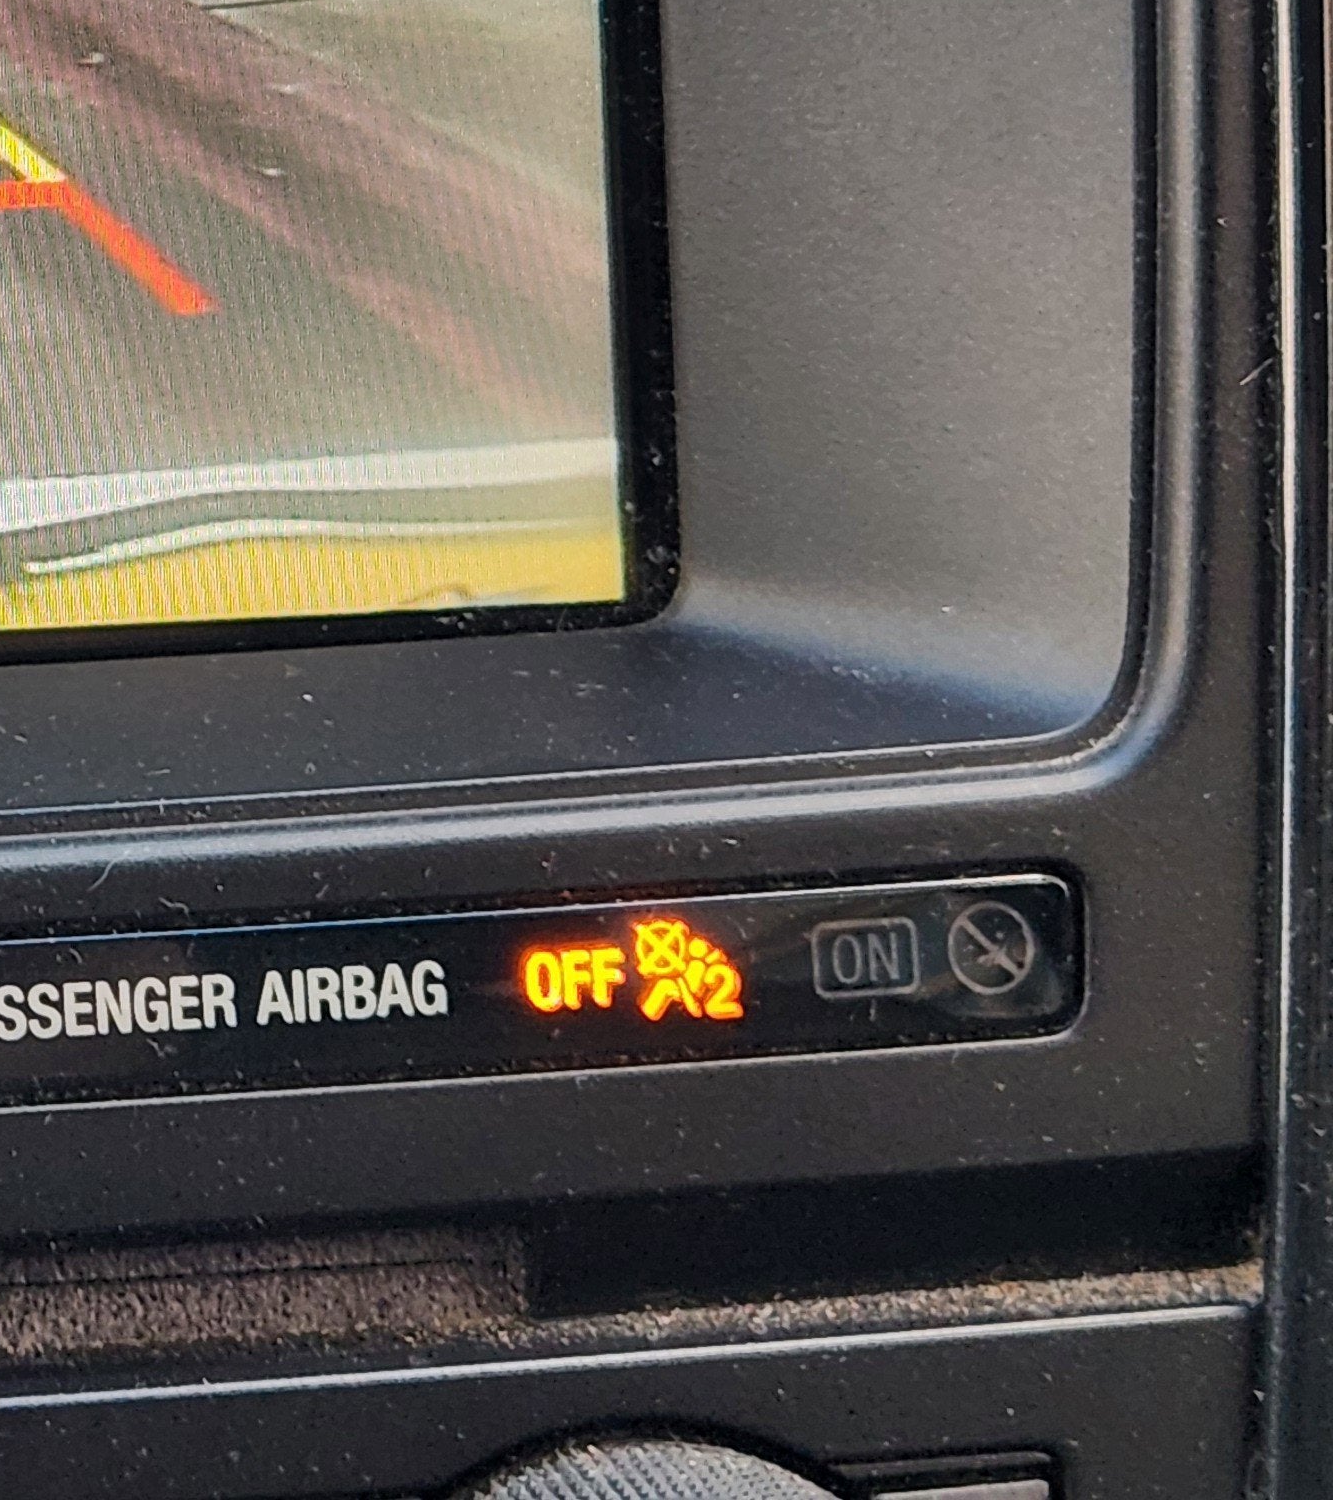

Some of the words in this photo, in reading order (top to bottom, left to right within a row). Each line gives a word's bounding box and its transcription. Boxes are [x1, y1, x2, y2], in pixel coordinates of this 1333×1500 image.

[257, 960, 448, 1026] AIRBAG
[522, 946, 627, 1013] OFF
[833, 932, 901, 985] ON
